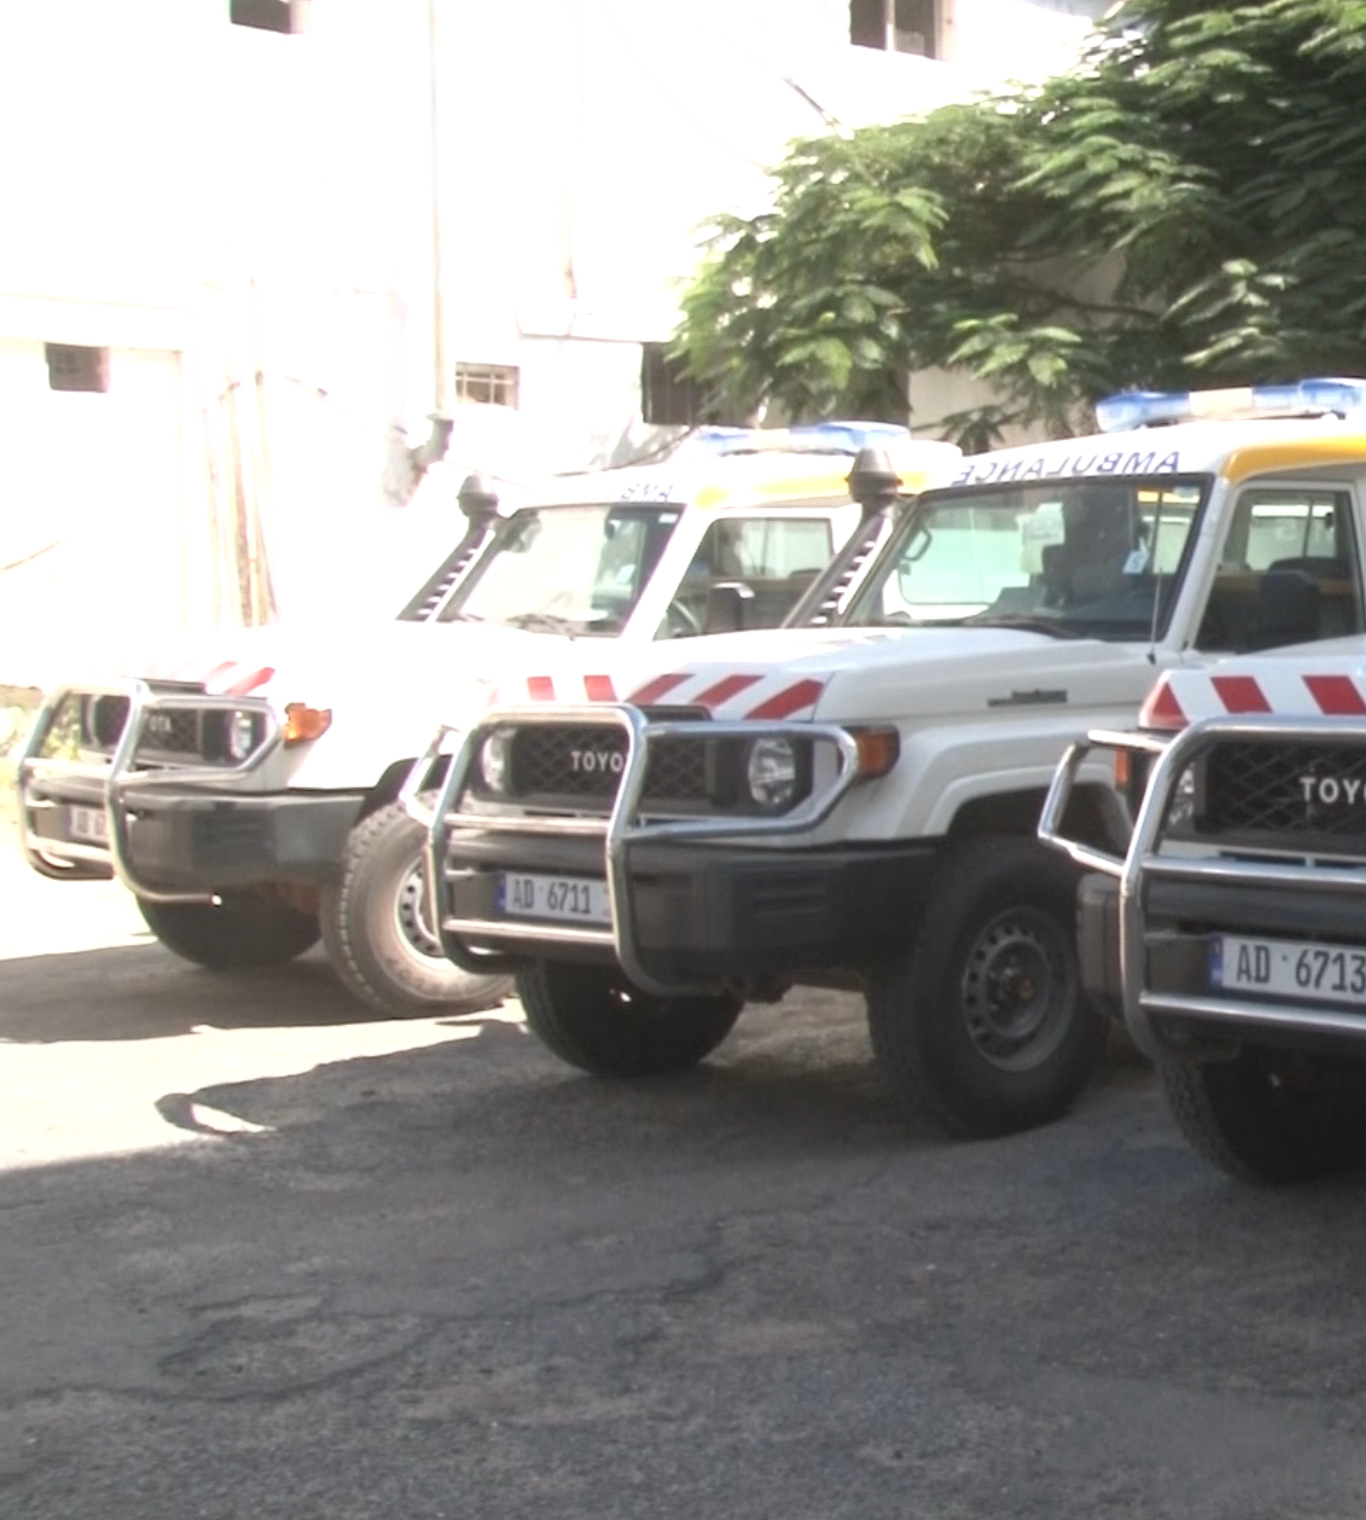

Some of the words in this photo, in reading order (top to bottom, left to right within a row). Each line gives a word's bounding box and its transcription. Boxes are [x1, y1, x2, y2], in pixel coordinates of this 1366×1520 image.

[570, 750, 624, 773] TOYO
[513, 879, 535, 909] AD
[547, 881, 591, 914] 6711
[1236, 944, 1271, 984] AD
[1295, 949, 1366, 995] 6713
